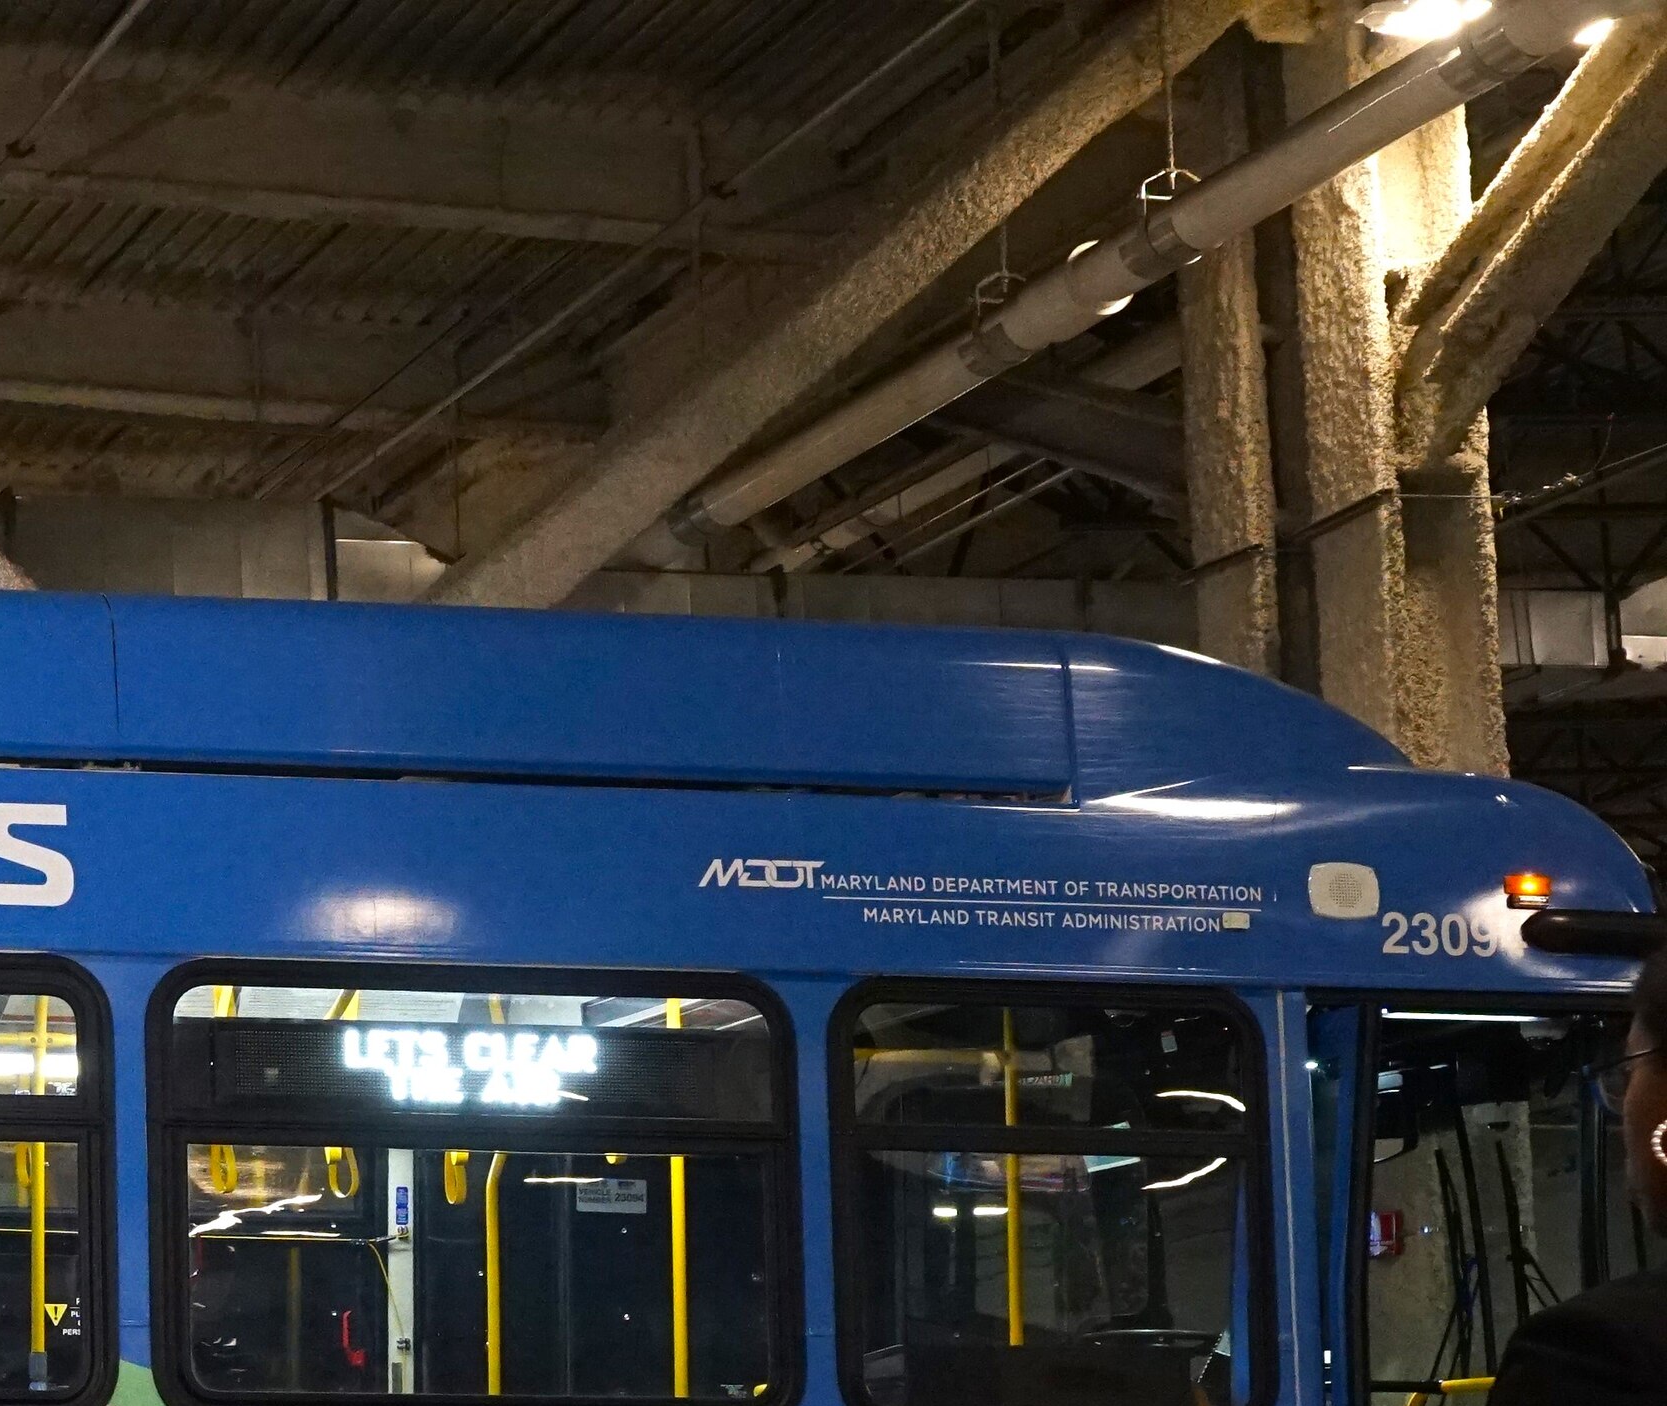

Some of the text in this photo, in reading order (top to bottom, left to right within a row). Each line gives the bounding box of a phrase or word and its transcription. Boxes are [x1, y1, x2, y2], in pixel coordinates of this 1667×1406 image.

[698, 858, 826, 889] MDOT
[820, 874, 1262, 902] MARYLAND DEPARTMENT OF TRANSPORTATION
[863, 907, 1221, 933] MARYLAND TRANSIT ADMINISTRATION
[463, 1031, 599, 1073] CLEAR
